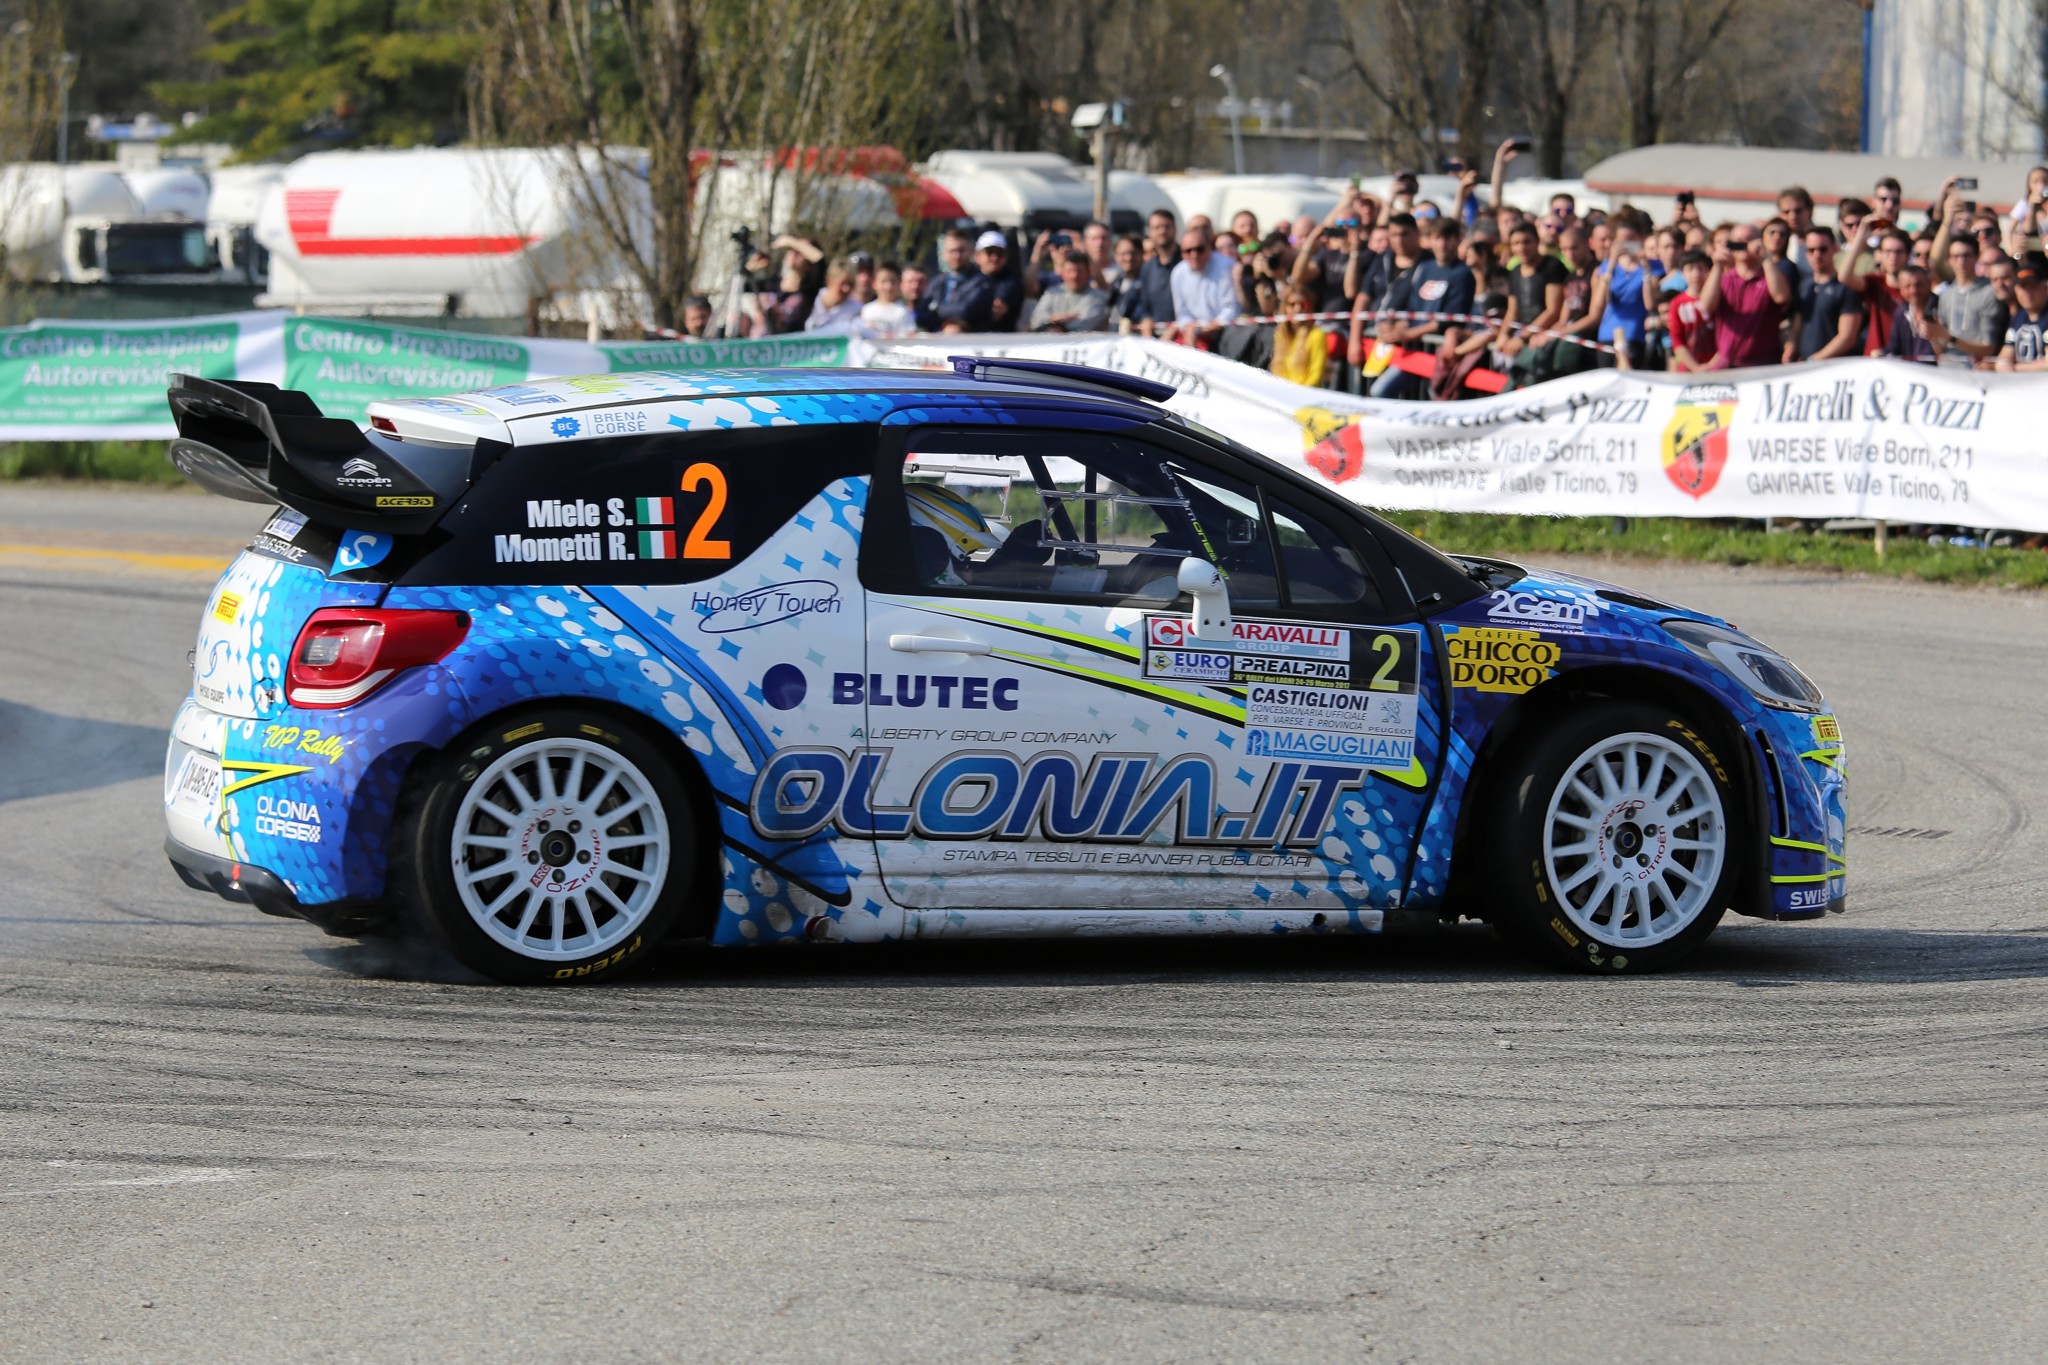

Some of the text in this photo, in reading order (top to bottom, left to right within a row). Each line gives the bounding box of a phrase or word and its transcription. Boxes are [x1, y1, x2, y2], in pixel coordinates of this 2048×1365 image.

[3, 327, 229, 362] Centro Prealpino
[295, 323, 519, 367] Centro Prealpino
[315, 357, 494, 389] Autorevisioni
[1753, 378, 1987, 430] Marelli & Pozzi
[557, 411, 647, 431] BC BRENA
[595, 421, 646, 434] CORSE
[1387, 438, 1482, 462] VARESE
[1606, 439, 1636, 462] 211
[1748, 438, 1825, 462] VARESE
[1884, 440, 1936, 469] Borri,
[1939, 445, 1973, 470] 211
[1553, 471, 1611, 496] Ticino,
[1617, 471, 1637, 494] 79
[1747, 472, 1835, 496] GAVIRATE
[1890, 475, 1946, 503] Ticino,
[1952, 480, 1969, 502] 79
[527, 498, 633, 528] Miele S.
[681, 462, 731, 559] 2
[495, 532, 635, 562] Mometti R.
[691, 591, 842, 617] Honey Touch
[1487, 590, 1585, 623] 2Gem
[1187, 621, 1340, 647] ARAVALLI
[1235, 641, 1290, 653] GROUP
[1475, 630, 1523, 640] CAFFÈ
[1174, 653, 1230, 669] EURO
[1369, 634, 1401, 691] 2
[1447, 639, 1552, 664] CHICCO
[1174, 667, 1230, 677] CERAMICHE
[1240, 658, 1347, 679] PREALPINA
[1454, 661, 1542, 687] D'ORO
[833, 672, 1020, 711] BLUTEC
[1252, 688, 1369, 711] CASTIGLIONI
[1251, 704, 1367, 721] CONCESSIONARIA UFFICIALE
[1252, 714, 1268, 722] PER
[1273, 716, 1303, 726] VARESE
[1317, 720, 1363, 730] PROVINCIA
[850, 728, 1117, 744] A LIBERTY GROUP COMPANY
[1368, 726, 1413, 735] PEUGEOT
[263, 725, 344, 765] TOP Rally
[1273, 731, 1412, 757] MAGUGLIANI
[257, 796, 321, 823] OLONIA
[748, 745, 1370, 848] OLONIA.IT
[256, 816, 311, 841] CORSE
[943, 850, 1312, 868] STAMPA TESSUTI E BANNER PUBBLICITARI
